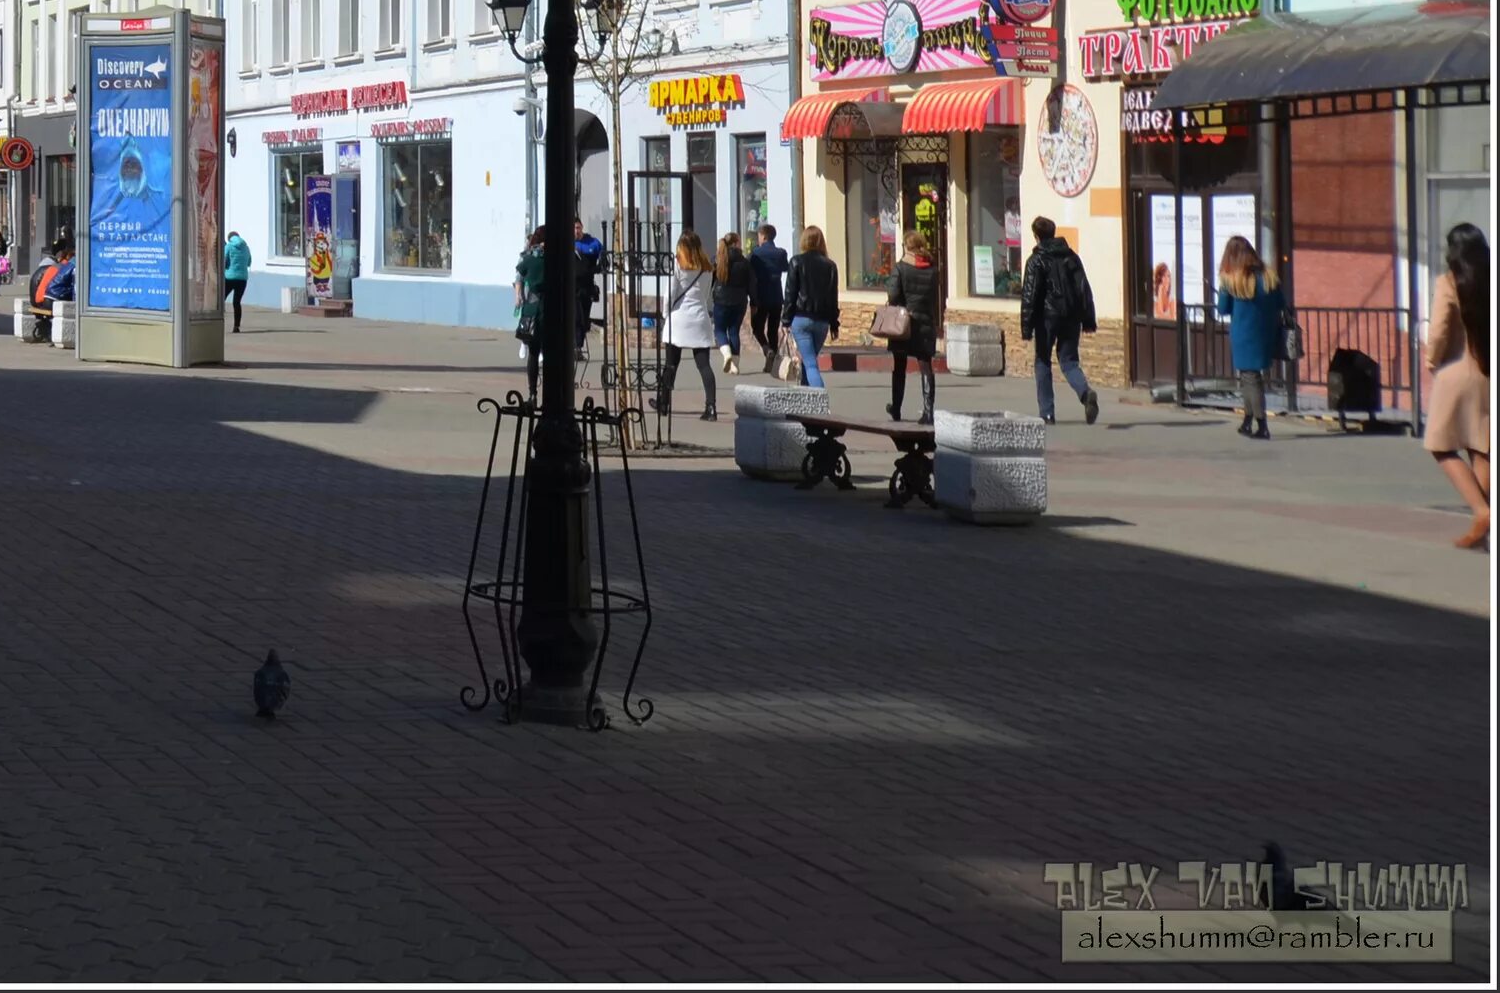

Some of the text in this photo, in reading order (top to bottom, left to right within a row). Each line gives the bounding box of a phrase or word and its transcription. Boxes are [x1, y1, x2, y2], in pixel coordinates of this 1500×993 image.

[97, 58, 144, 77] Discovery
[99, 79, 152, 89] OCEAN
[649, 74, 743, 108] ЯРМАРКА
[98, 107, 170, 137] ОКЕАНАРИУМ
[666, 109, 726, 126] СУВЕНИРОВ
[99, 221, 141, 231] ПЕРВЫЙ
[99, 232, 105, 242] В
